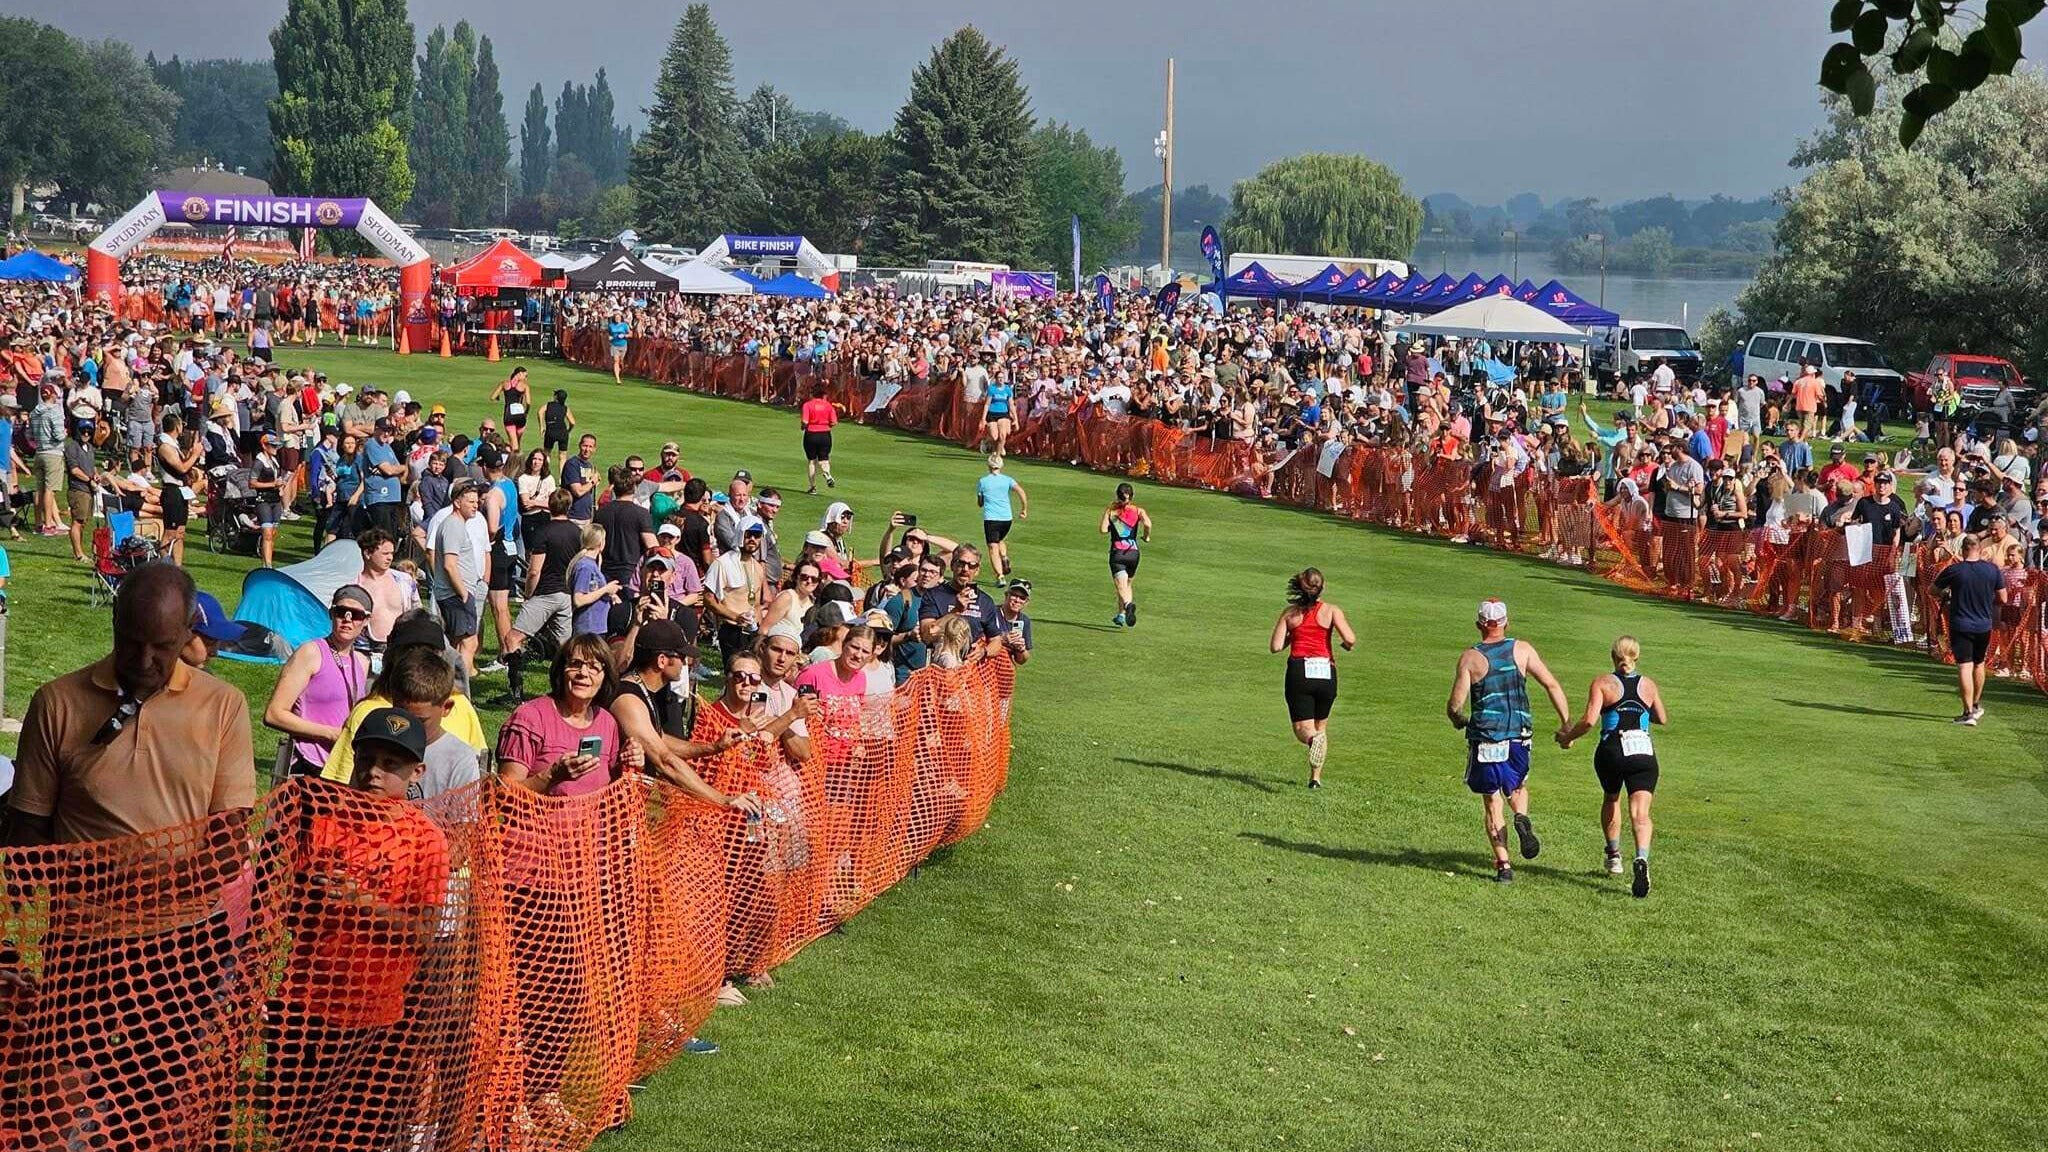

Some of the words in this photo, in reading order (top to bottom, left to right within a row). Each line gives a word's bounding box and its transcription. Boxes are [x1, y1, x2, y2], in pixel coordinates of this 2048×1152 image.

[214, 198, 312, 224] FINISH
[106, 207, 160, 252] SPUDMAN
[364, 216, 415, 262] SPUDMAN
[734, 240, 758, 251] BIKE
[759, 240, 794, 252] FINISH
[605, 280, 657, 288] BROOKSEE
